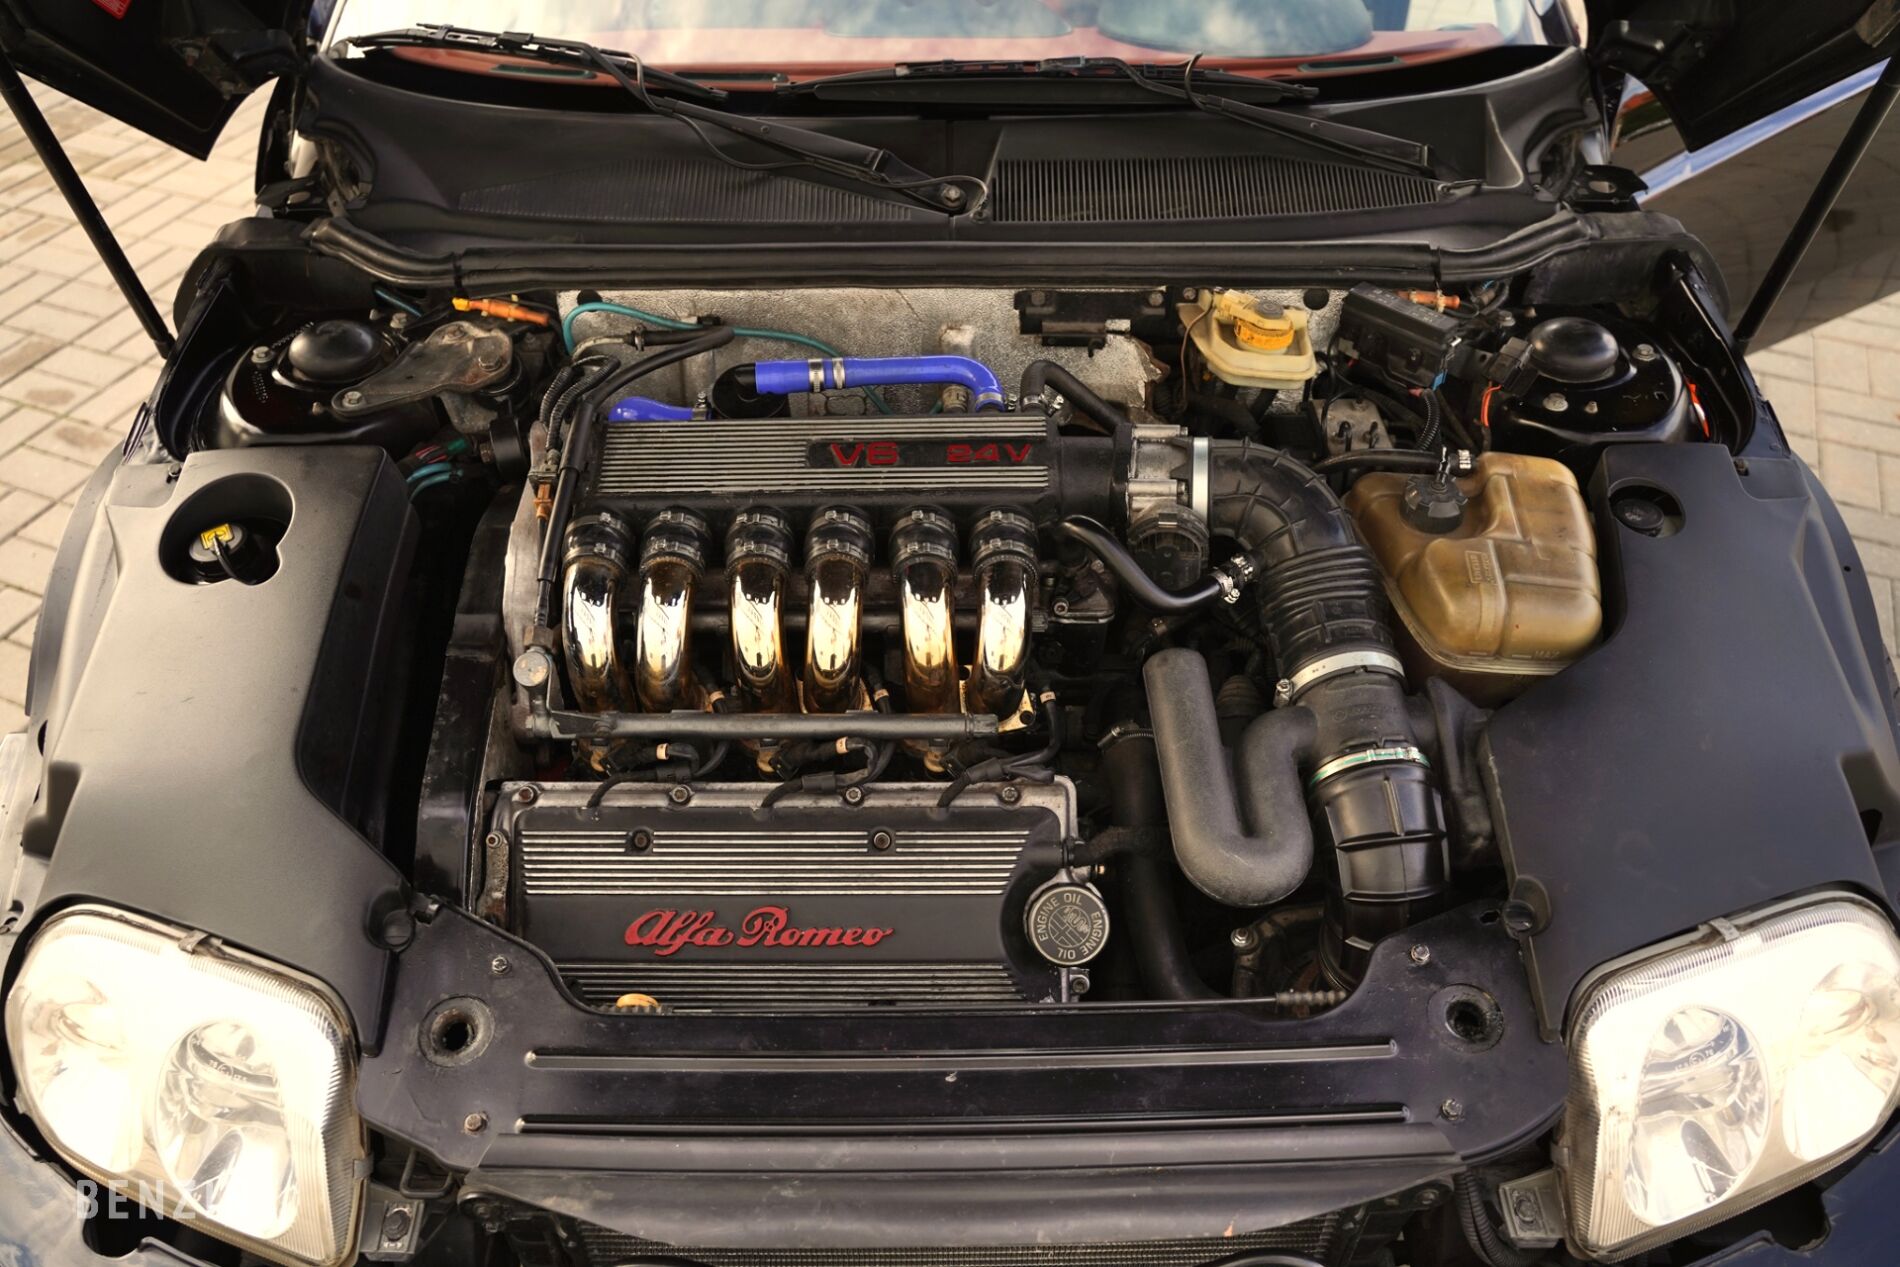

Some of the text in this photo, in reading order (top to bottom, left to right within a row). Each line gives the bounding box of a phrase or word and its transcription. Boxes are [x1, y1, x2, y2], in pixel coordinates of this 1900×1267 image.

[831, 441, 1032, 467] V6 24V
[624, 905, 894, 957] Alfa Romeo
[1036, 892, 1082, 942] ENGINE OIL
[1057, 911, 1103, 960] ENGINE OIL
